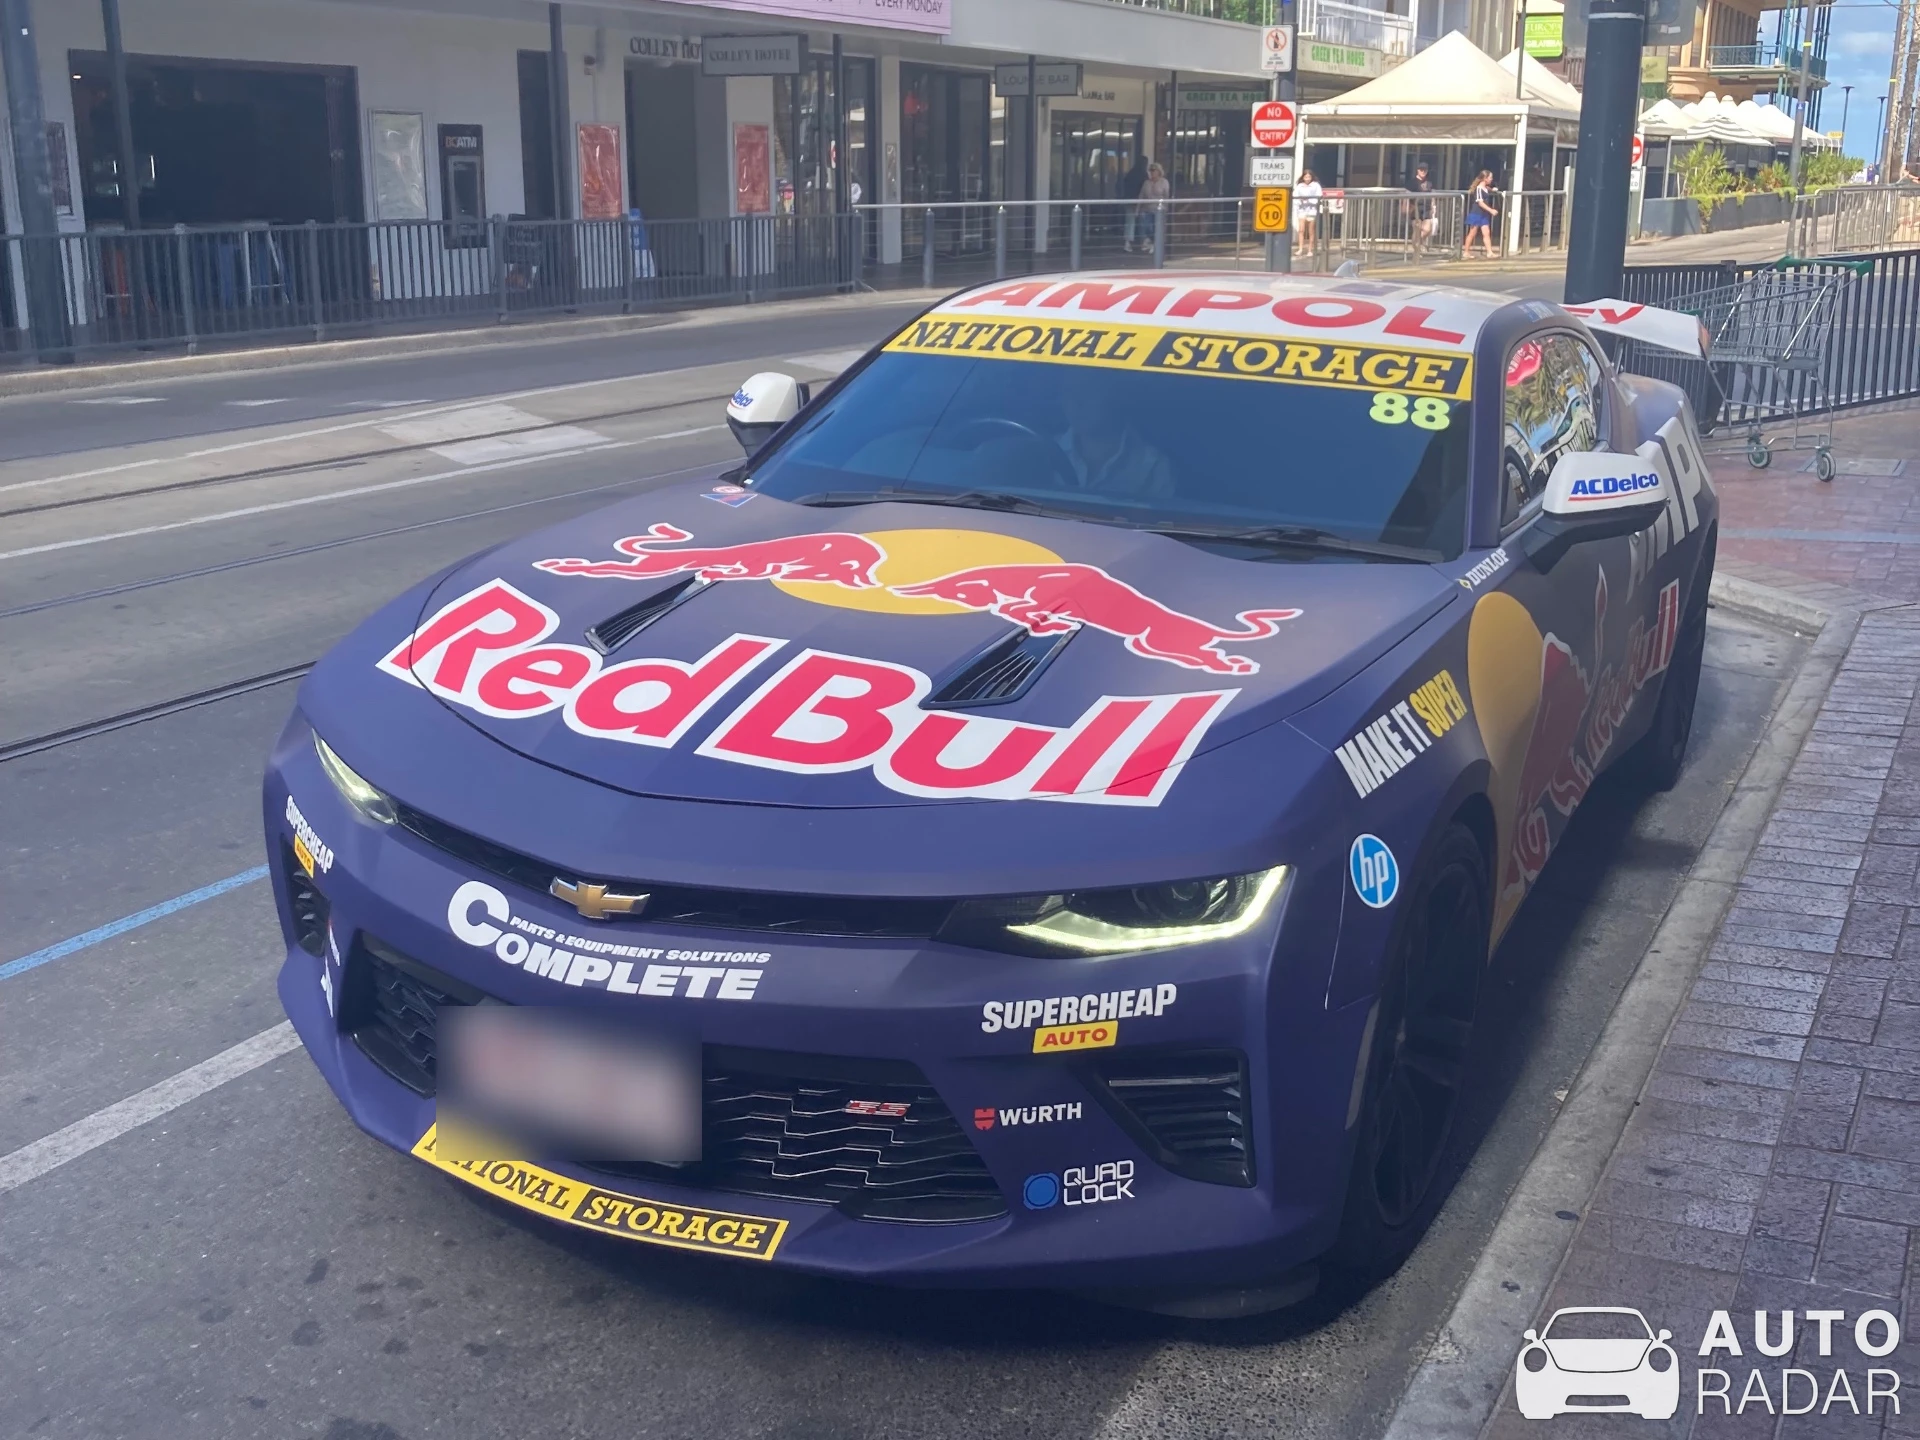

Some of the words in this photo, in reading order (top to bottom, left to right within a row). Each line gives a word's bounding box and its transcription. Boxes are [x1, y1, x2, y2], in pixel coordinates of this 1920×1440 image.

[906, 0, 943, 14] MONDAY
[1311, 45, 1331, 63] GREEN
[1332, 47, 1344, 64] TEA
[1346, 49, 1365, 67] HOUSE
[1048, 74, 1070, 84] BAR
[1266, 107, 1282, 118] NO
[1260, 131, 1287, 142] ENTRY
[1253, 173, 1290, 181] EXCEPTED
[1259, 162, 1285, 170] TRAMS
[1264, 211, 1279, 220] 10
[967, 281, 1466, 345] AMPOL
[897, 320, 1138, 361] NATIONAL
[1164, 335, 1451, 392] STORAGE
[1369, 391, 1451, 431] 88
[1570, 472, 1660, 497] ACDelco
[1465, 548, 1509, 586] DUNLOP
[385, 582, 780, 742] Red
[705, 652, 1232, 800] Bull
[1409, 669, 1467, 738] SUPER
[1390, 700, 1433, 753] IT
[1335, 715, 1416, 799] MAKE
[285, 795, 334, 874] SUPERCHEAP
[1358, 838, 1390, 905] hp
[447, 880, 764, 1000] COMPLETE
[509, 915, 556, 940] PARTS
[555, 932, 566, 944] &
[565, 932, 664, 960] EQUIPMENT
[665, 949, 772, 964] SOLUTIONS
[981, 983, 1177, 1034] SUPERCHEAP
[1041, 1027, 1109, 1048] AUTO
[843, 1099, 912, 1117] SS
[999, 1102, 1082, 1126] WÜRTH
[1063, 1159, 1135, 1187] QUAD
[1063, 1178, 1135, 1206] LOCK
[582, 1195, 768, 1251] STORAGE
